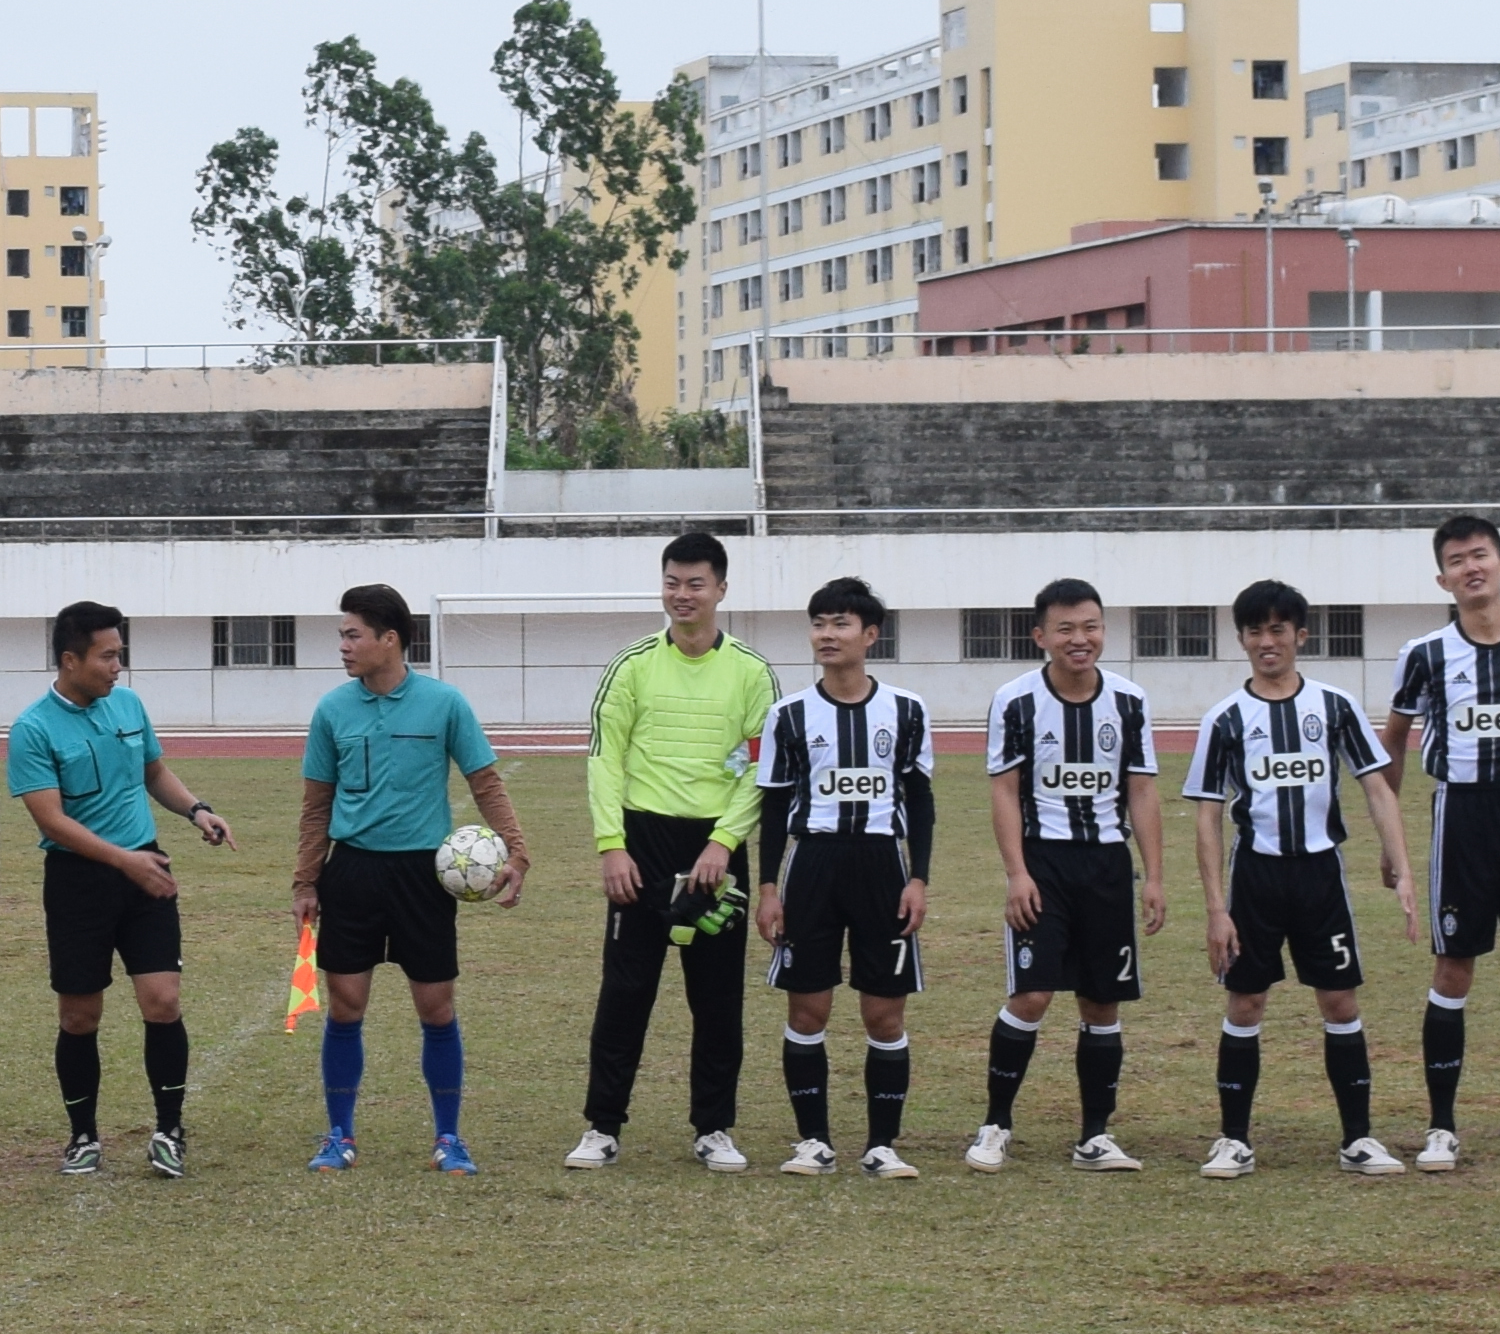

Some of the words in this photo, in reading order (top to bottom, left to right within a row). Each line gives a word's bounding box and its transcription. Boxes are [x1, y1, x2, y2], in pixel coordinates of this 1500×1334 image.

[818, 770, 886, 799] Jeep
[1042, 764, 1112, 794] Jeep
[1252, 755, 1325, 783] Jeep
[890, 938, 907, 976] 7
[1117, 945, 1133, 981] 2
[1331, 933, 1350, 970] 5
